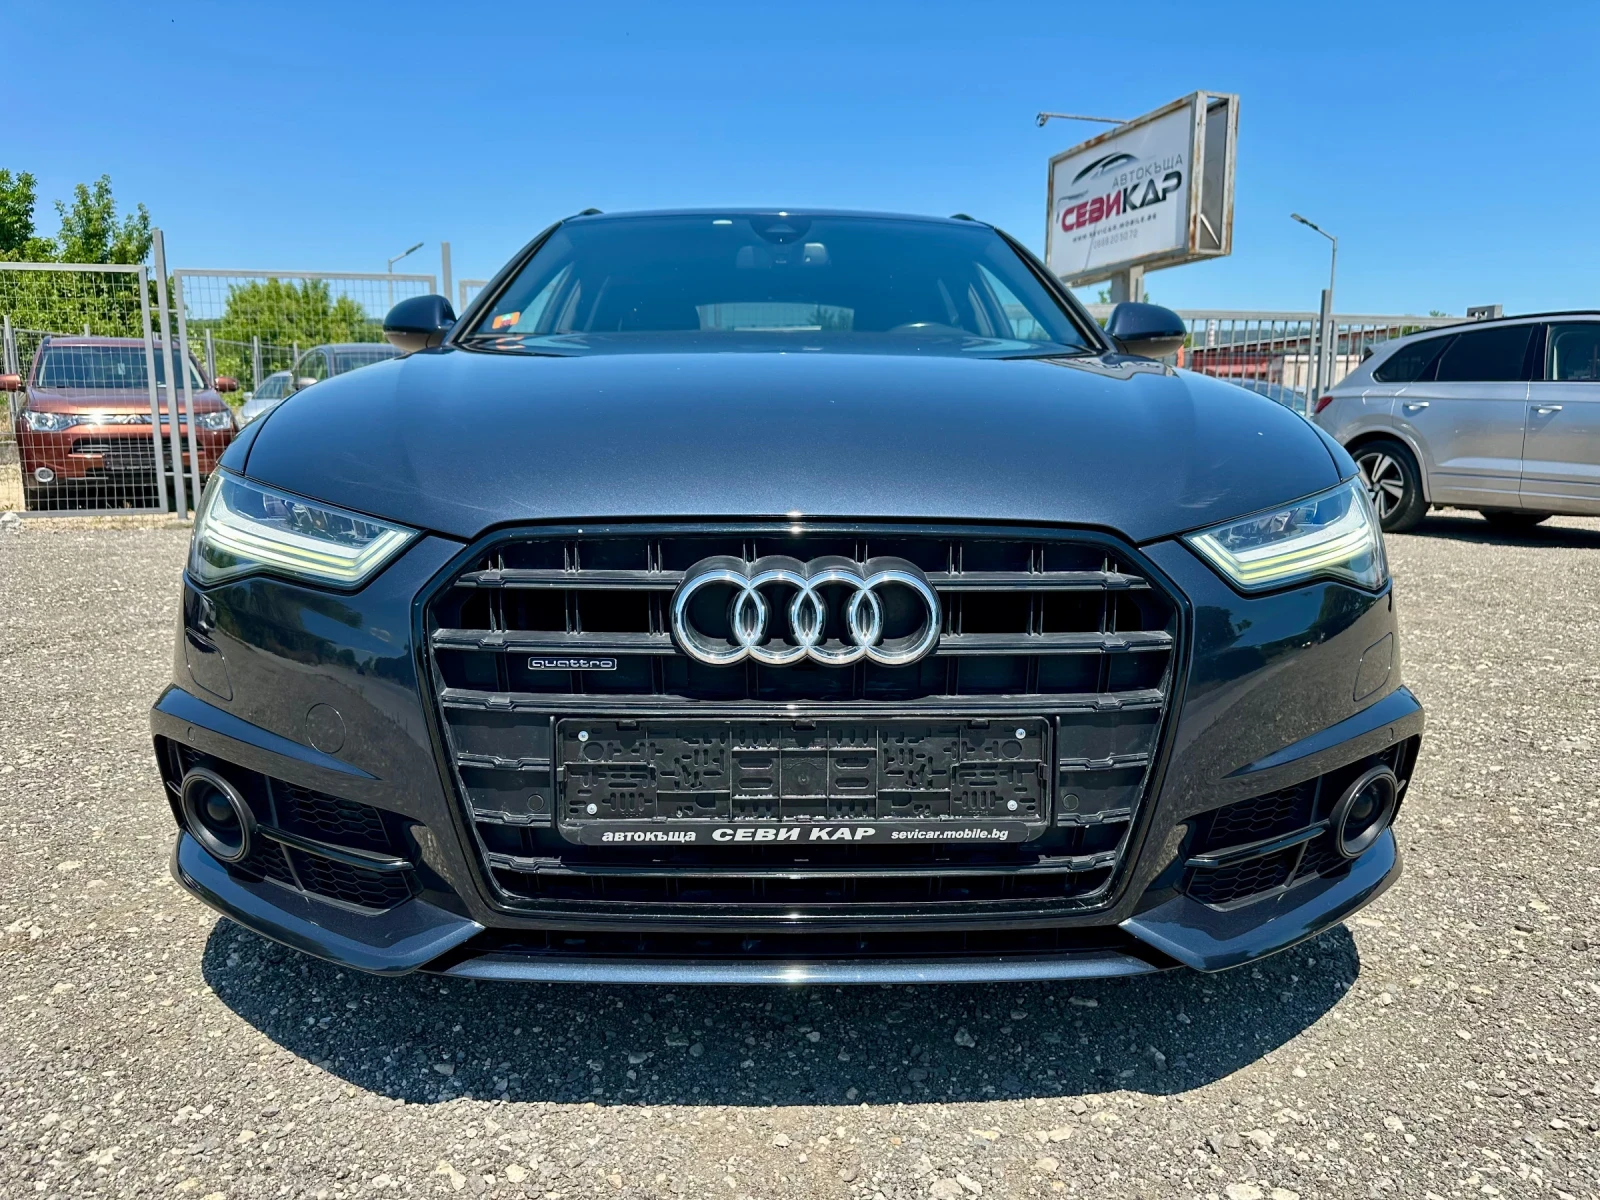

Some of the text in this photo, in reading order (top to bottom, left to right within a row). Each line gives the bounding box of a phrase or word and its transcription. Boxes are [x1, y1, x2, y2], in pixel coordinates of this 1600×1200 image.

[1112, 154, 1183, 189] АВТОКЪЩА
[532, 660, 612, 669] quattro
[602, 827, 1008, 843] автокъща СЕВИ КАР sevicar.mobile.bg
